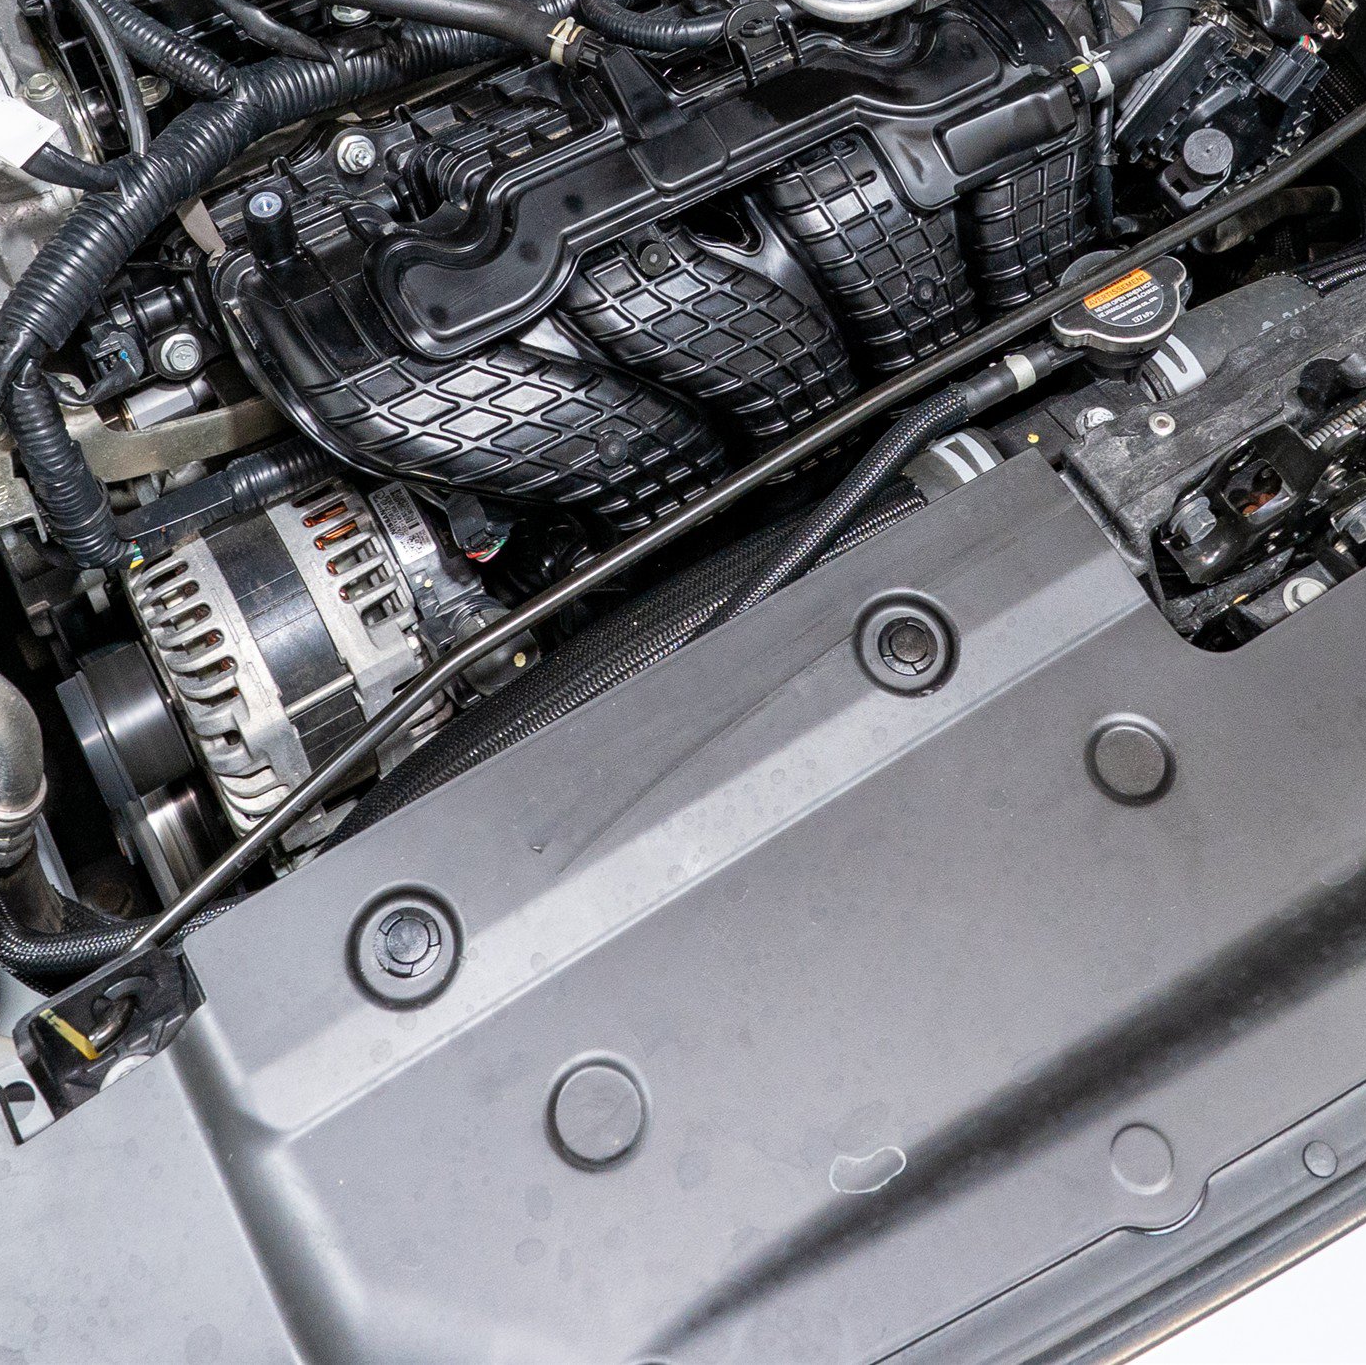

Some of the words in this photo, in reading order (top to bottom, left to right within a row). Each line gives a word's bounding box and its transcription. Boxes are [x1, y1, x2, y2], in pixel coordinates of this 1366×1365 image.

[1087, 272, 1147, 308] AVERTISSEMENT
[1093, 301, 1112, 313] NEVER
[1109, 294, 1126, 305] OPEN
[1124, 286, 1142, 298] WHEN
[1130, 313, 1143, 323] 137
[1140, 308, 1154, 319] kPa
[378, 508, 397, 535] NISSAN
